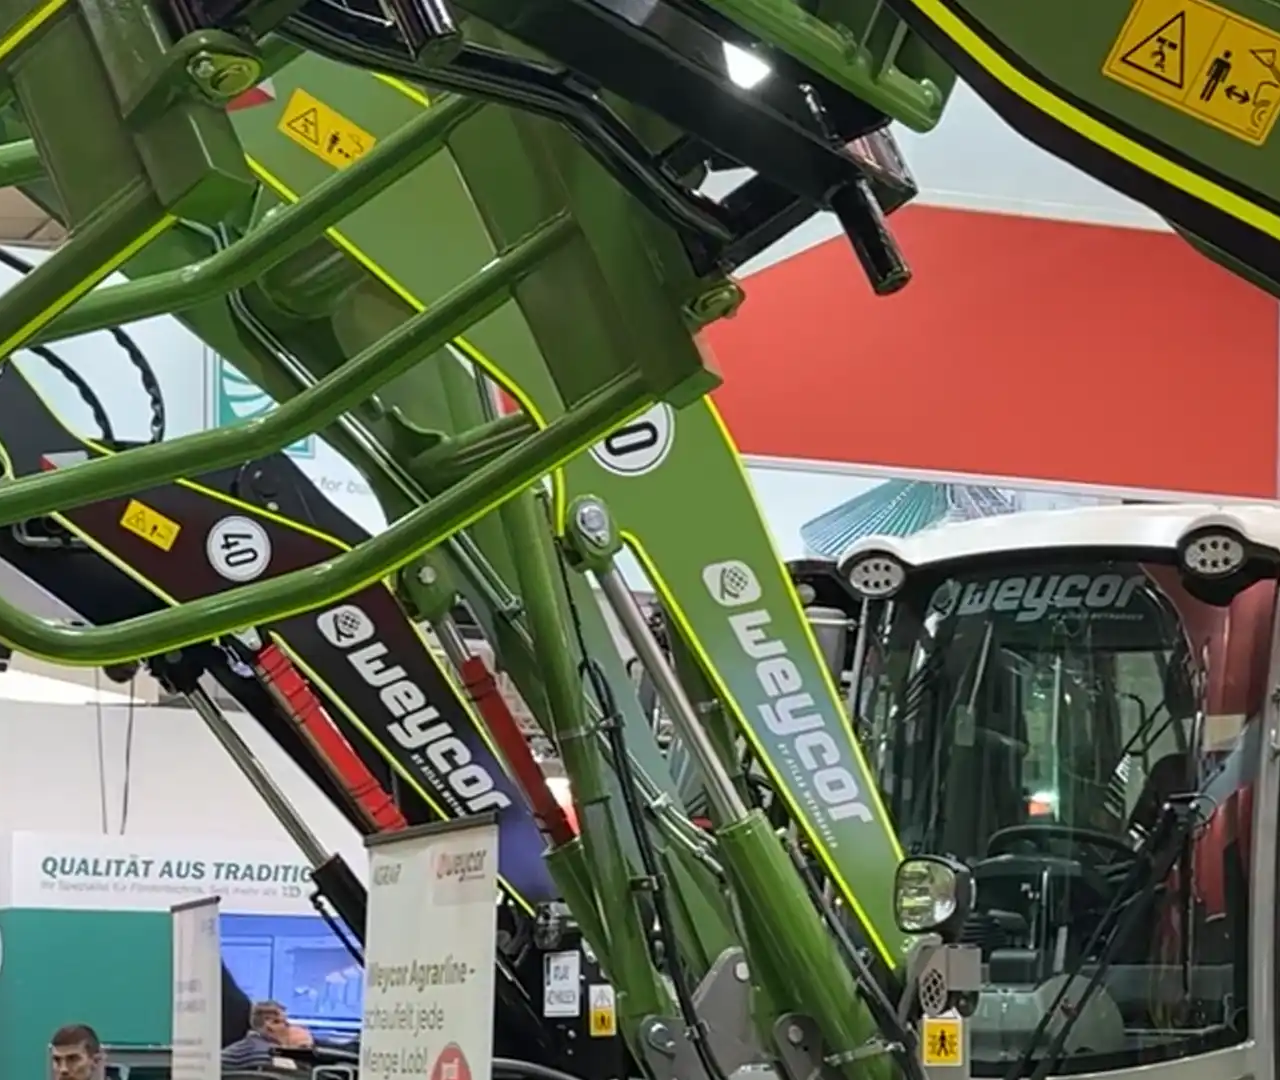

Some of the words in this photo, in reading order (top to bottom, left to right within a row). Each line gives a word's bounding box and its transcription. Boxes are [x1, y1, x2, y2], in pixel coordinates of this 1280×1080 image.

[603, 419, 659, 458] 0
[220, 532, 259, 568] 40
[956, 573, 1148, 622] weycor
[346, 641, 513, 812] weycor
[728, 608, 874, 824] weycor
[41, 853, 154, 880] QUALITÄT
[158, 860, 207, 881] AUS
